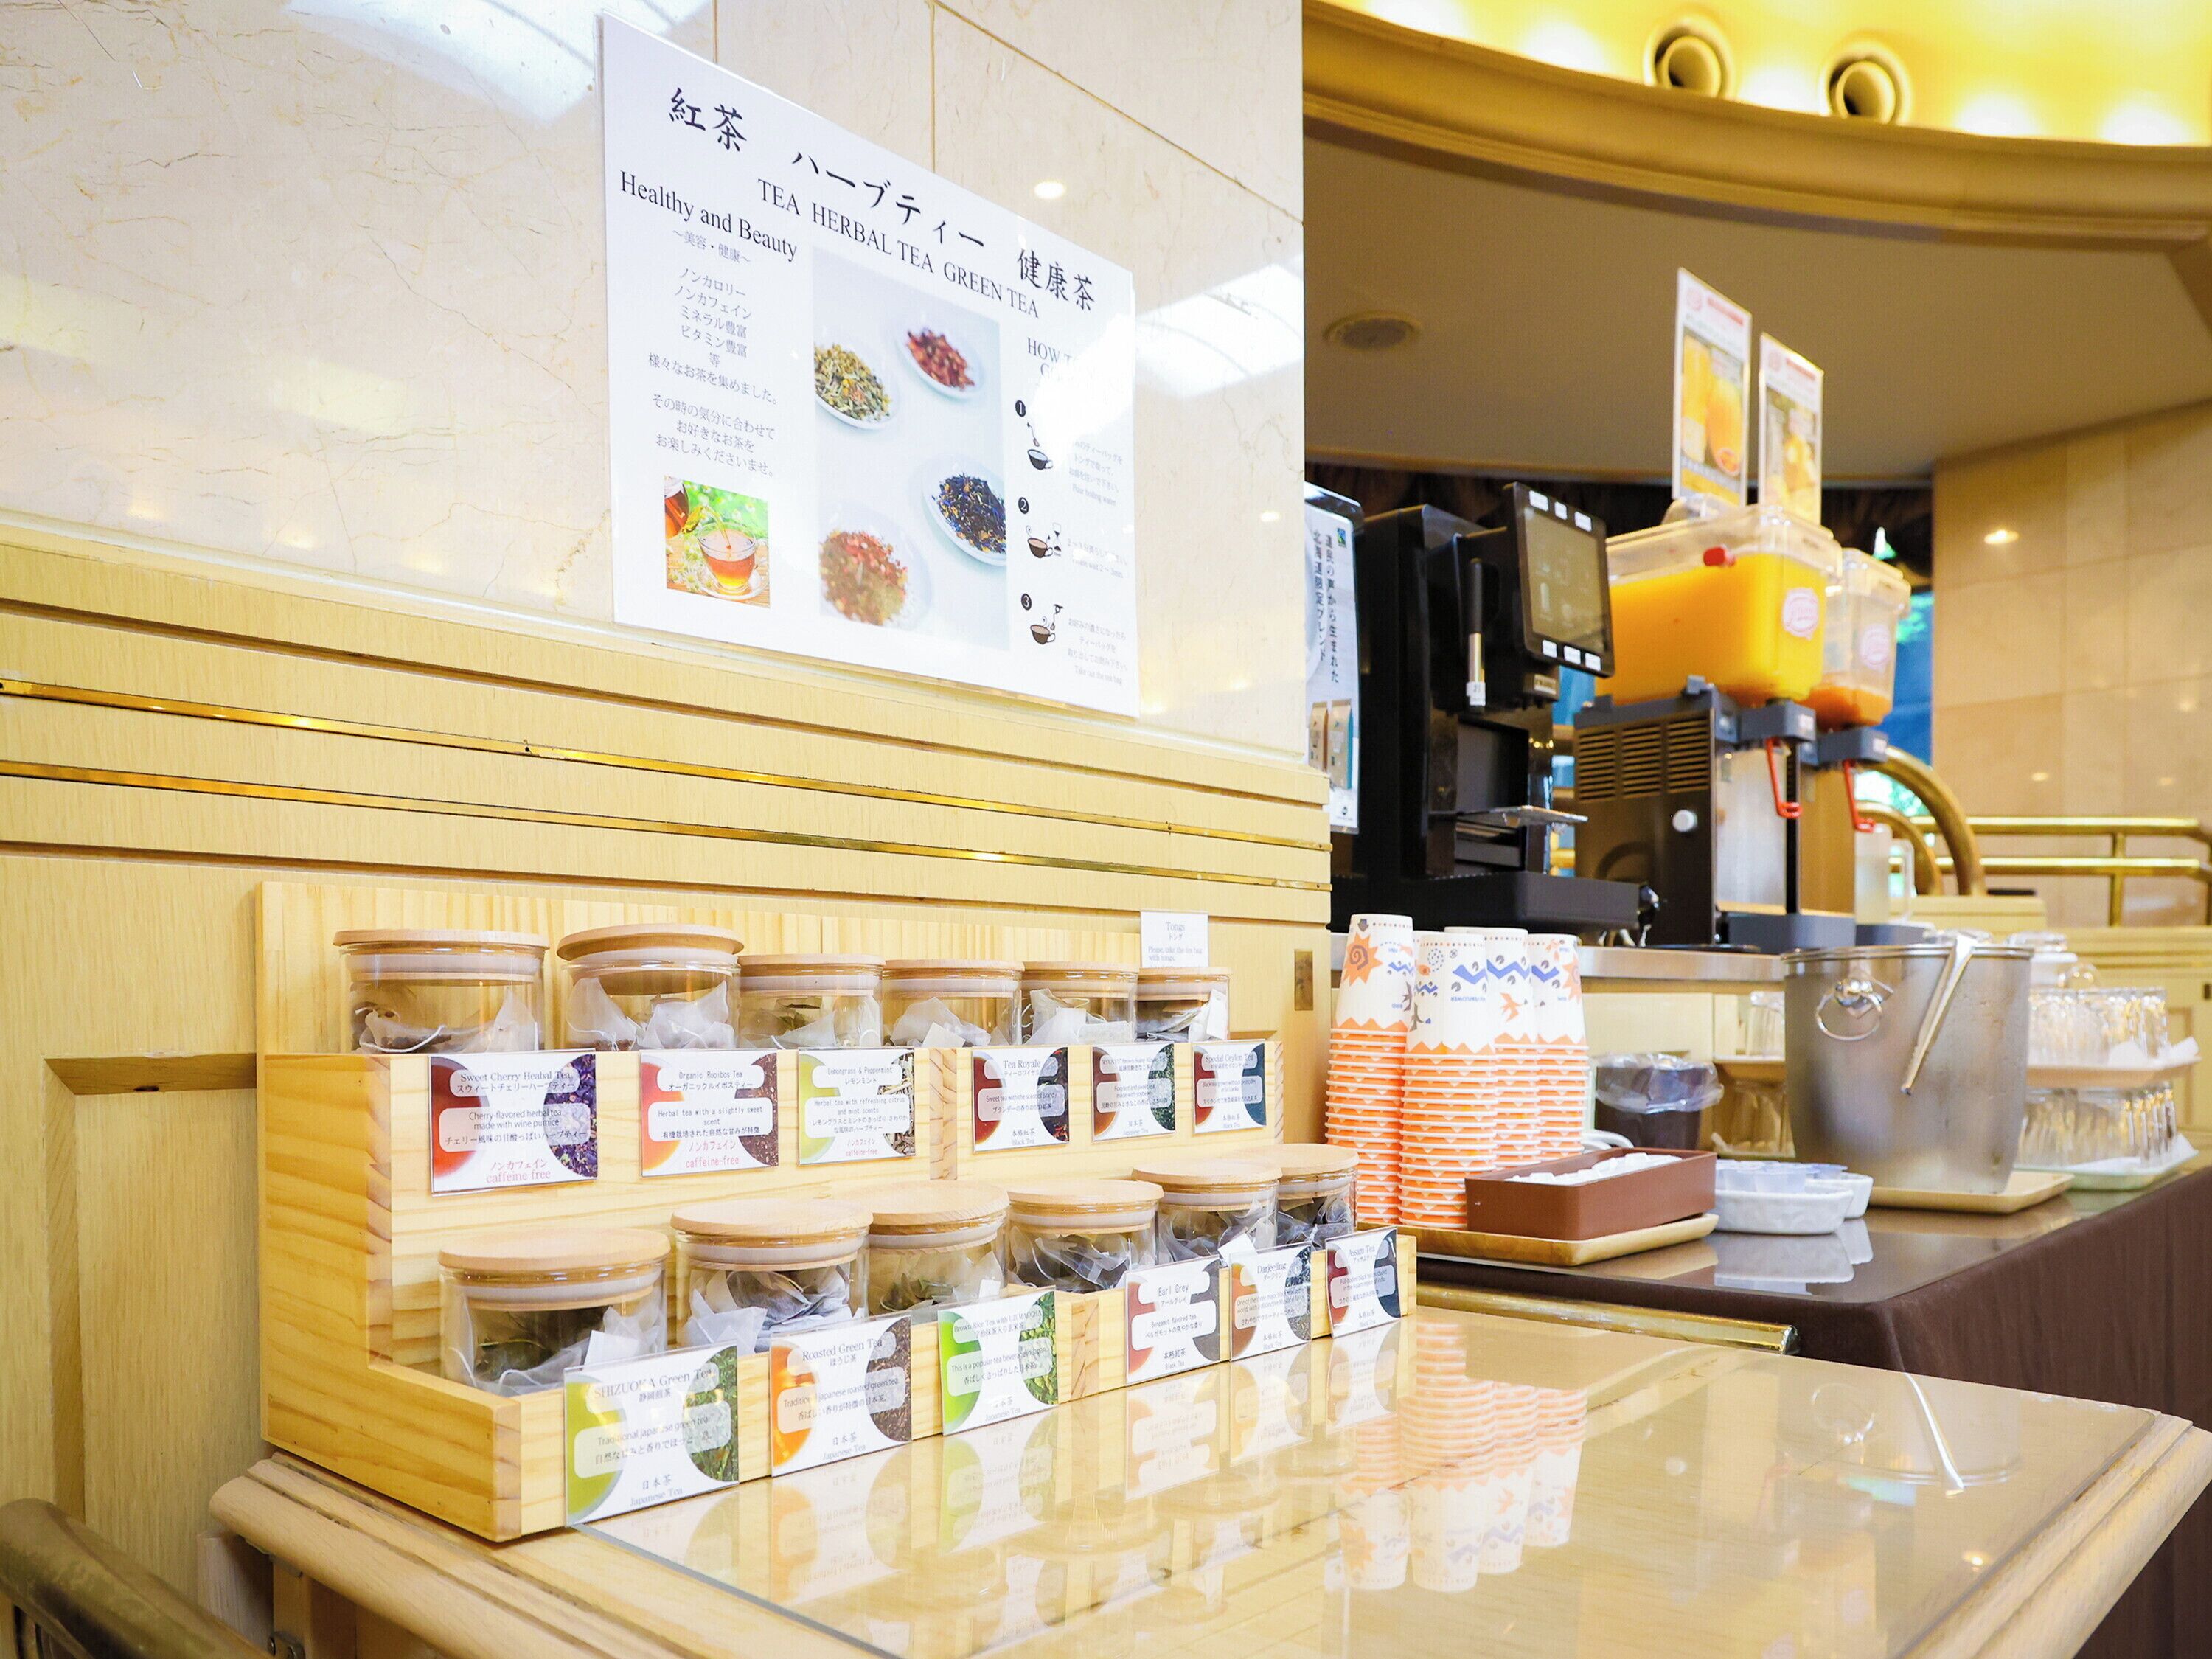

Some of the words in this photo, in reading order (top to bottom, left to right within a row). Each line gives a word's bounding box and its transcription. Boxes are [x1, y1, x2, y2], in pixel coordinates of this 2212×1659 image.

[669, 87, 746, 152] 紅茶
[791, 151, 985, 249] ハーブティー
[1017, 248, 1096, 312] 健康茶
[620, 170, 694, 222] Healthy
[700, 209, 732, 234] and
[739, 218, 797, 262] Beauty
[757, 178, 801, 217] TEA
[811, 201, 892, 256] HERBAL
[897, 240, 934, 274] TEA
[943, 260, 1003, 302] GREEN
[1006, 287, 1040, 319] TEA
[680, 268, 745, 296] ノンカロリー
[675, 286, 752, 319] ノンカフェイン
[681, 305, 747, 338] ミネラル豊富
[681, 325, 747, 358] ビタミン豊富
[1027, 337, 1061, 364] HOW
[709, 352, 720, 367] 等
[649, 352, 778, 405] 様々なお茶を集めました。
[653, 394, 775, 440] その時の気分に合わせて
[676, 420, 754, 453] お好きなお茶を
[656, 434, 773, 477] お楽しみくださいませ。
[1003, 1060, 1015, 1069] Tea
[1018, 1060, 1041, 1068] Royale
[460, 1073, 487, 1082] Sweet
[490, 1071, 521, 1082] Cherry
[555, 1071, 571, 1079] Tea
[679, 1071, 703, 1079] Organic
[457, 1081, 575, 1093] スウィートチェリーハーブティー
[669, 1082, 753, 1091] オーガニックルイボスティー
[718, 1106, 744, 1115] slightly
[474, 1122, 495, 1130] made
[533, 1119, 559, 1127] pumice
[689, 1141, 735, 1152] ノンカフェイン
[490, 1158, 546, 1172] ノンカフェイン
[1257, 1262, 1287, 1274] Darjeeling
[1158, 1287, 1172, 1297] Earl
[1175, 1284, 1189, 1293] Grey
[954, 1324, 972, 1333] Brown
[802, 1346, 836, 1361] Roasted
[838, 1341, 864, 1353] Green
[868, 1338, 883, 1348] Tea
[1164, 1348, 1186, 1360] 本格紅茶
[830, 1355, 857, 1367] ほうじ茶
[659, 1373, 690, 1386] Green
[694, 1369, 712, 1380] Tea
[832, 1432, 857, 1446] 日本茶
[823, 1447, 852, 1460] Japanese
[855, 1444, 866, 1452] Tea
[642, 1475, 672, 1490] 日本茶
[630, 1492, 666, 1506] Japanese
[669, 1488, 683, 1498] Tea
